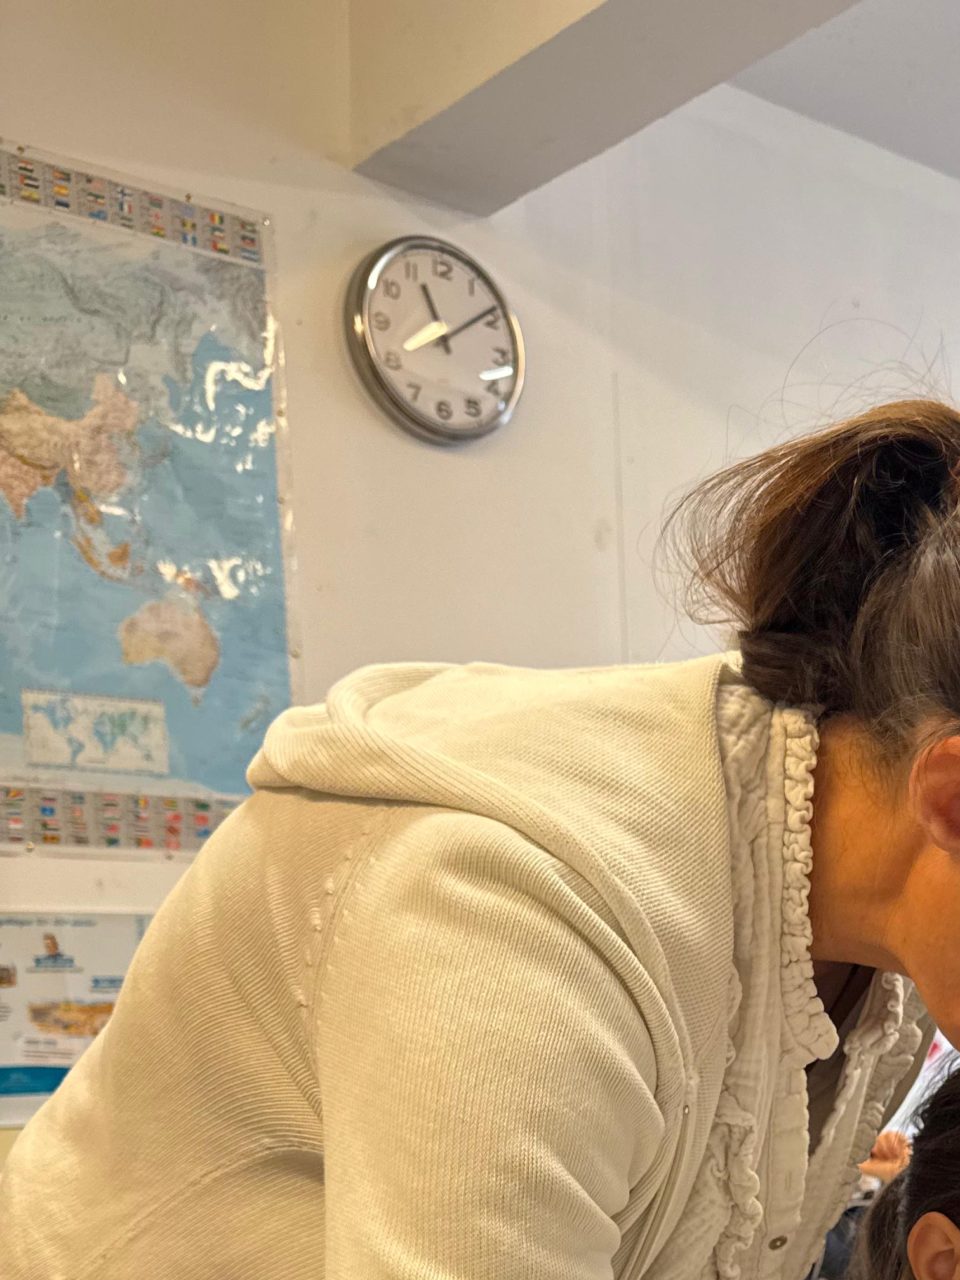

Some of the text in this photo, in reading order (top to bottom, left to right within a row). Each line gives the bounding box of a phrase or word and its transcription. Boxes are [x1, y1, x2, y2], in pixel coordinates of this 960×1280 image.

[404, 262, 418, 281] 11
[432, 258, 453, 281] 12
[383, 279, 400, 300] 10
[374, 312, 391, 331] 9
[485, 313, 499, 330] 2
[492, 347, 509, 366] 3
[407, 382, 421, 401] 7
[436, 401, 453, 420] 6
[465, 397, 482, 417] 5
